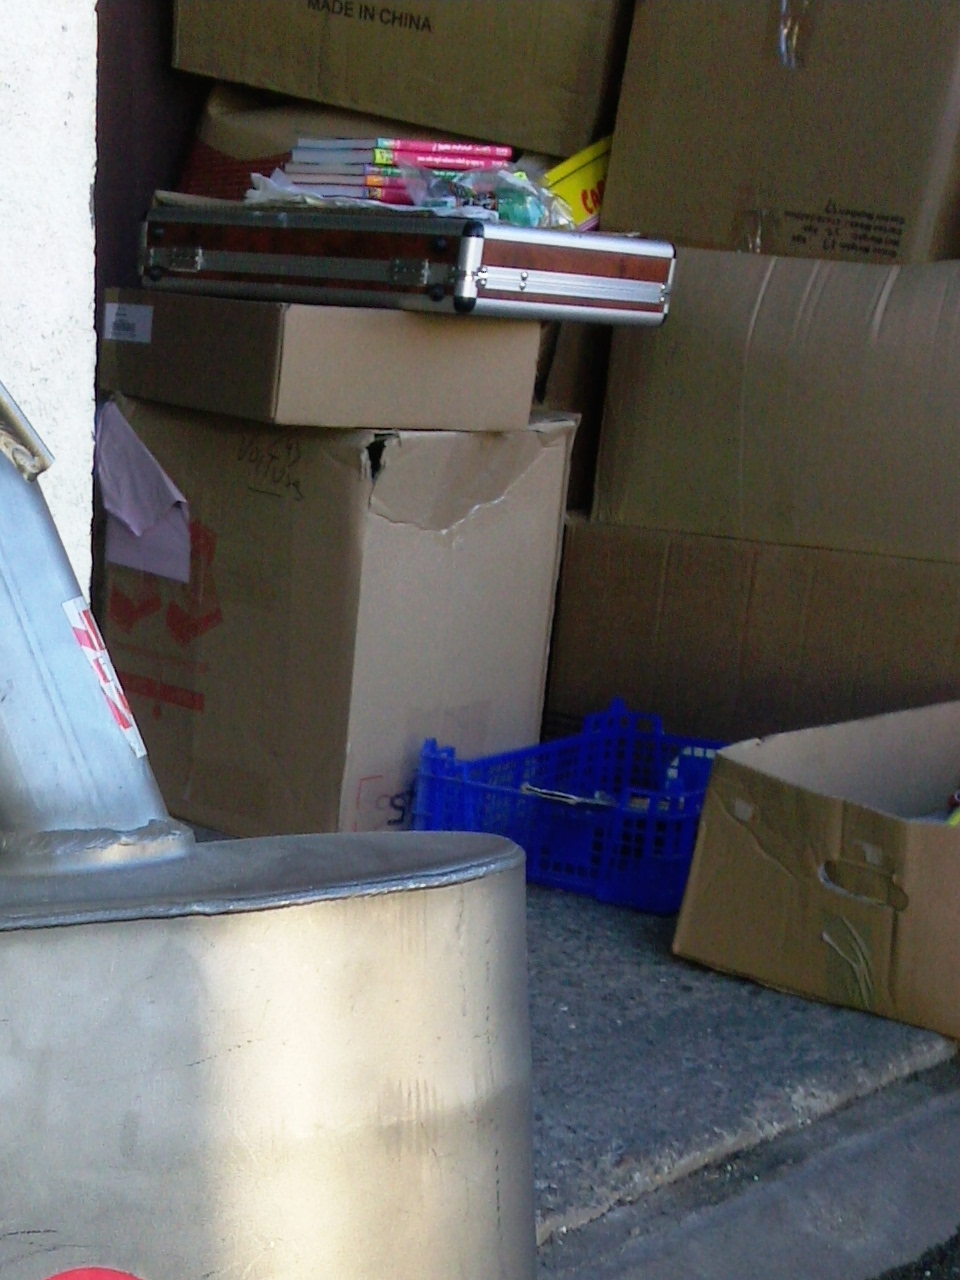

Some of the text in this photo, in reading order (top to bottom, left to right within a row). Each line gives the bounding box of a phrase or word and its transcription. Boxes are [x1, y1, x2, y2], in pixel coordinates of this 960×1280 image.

[307, 0, 432, 33] MADE IN CHINA
